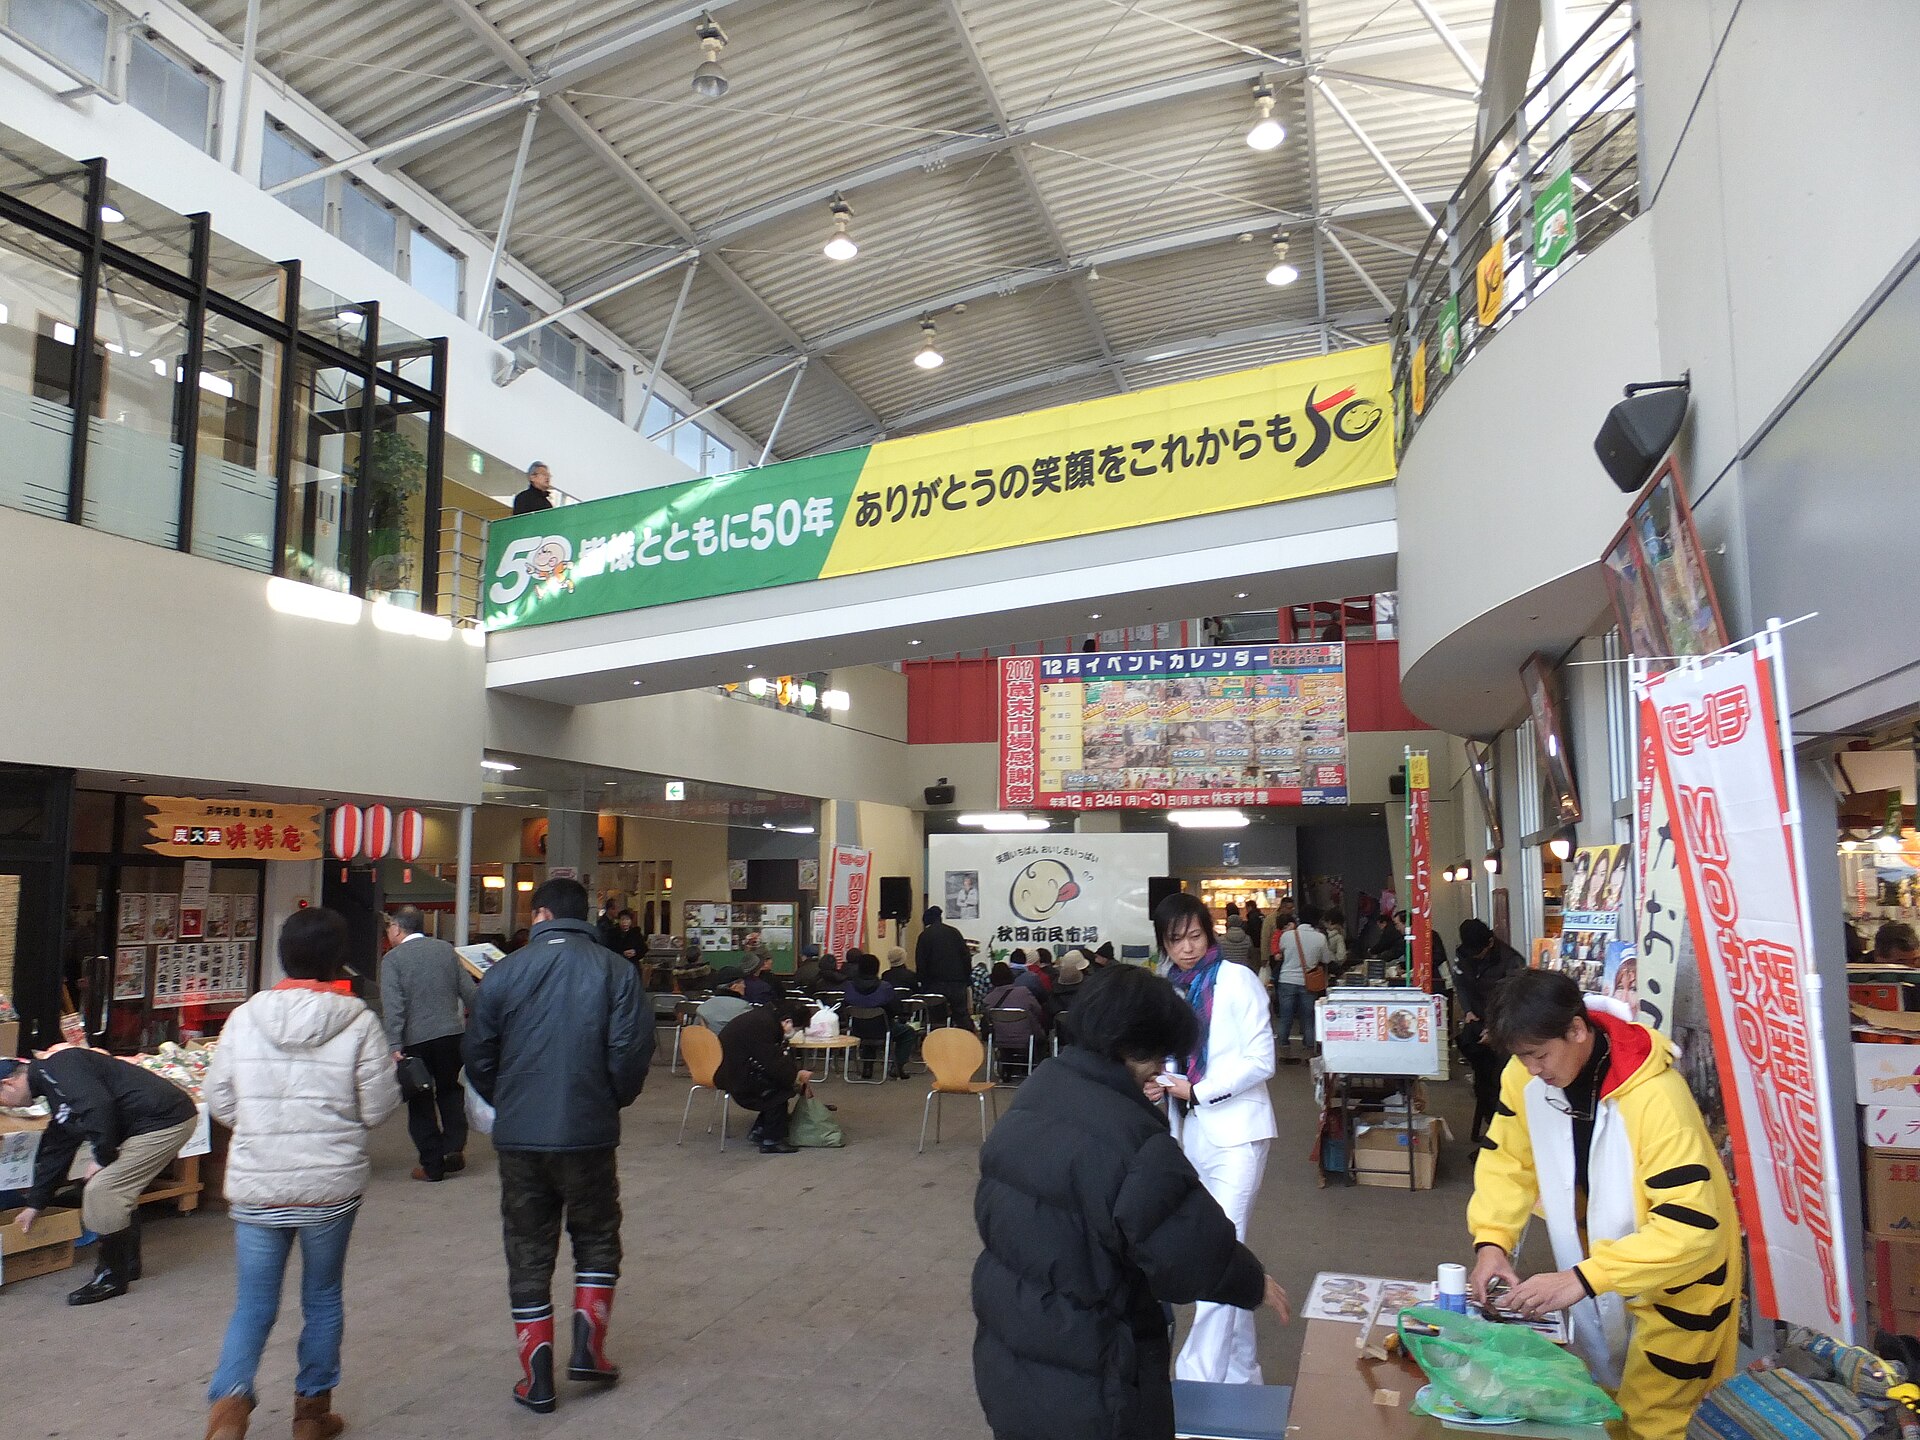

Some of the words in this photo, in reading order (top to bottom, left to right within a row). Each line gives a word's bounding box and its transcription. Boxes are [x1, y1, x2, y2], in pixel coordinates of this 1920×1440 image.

[855, 412, 1297, 527] ありがとうの笑顔をこれからも
[575, 497, 835, 577] 皆様とともに50年
[1042, 650, 1268, 676] 12月イベントカレンダー
[997, 925, 1099, 942] 秋田市民市場
